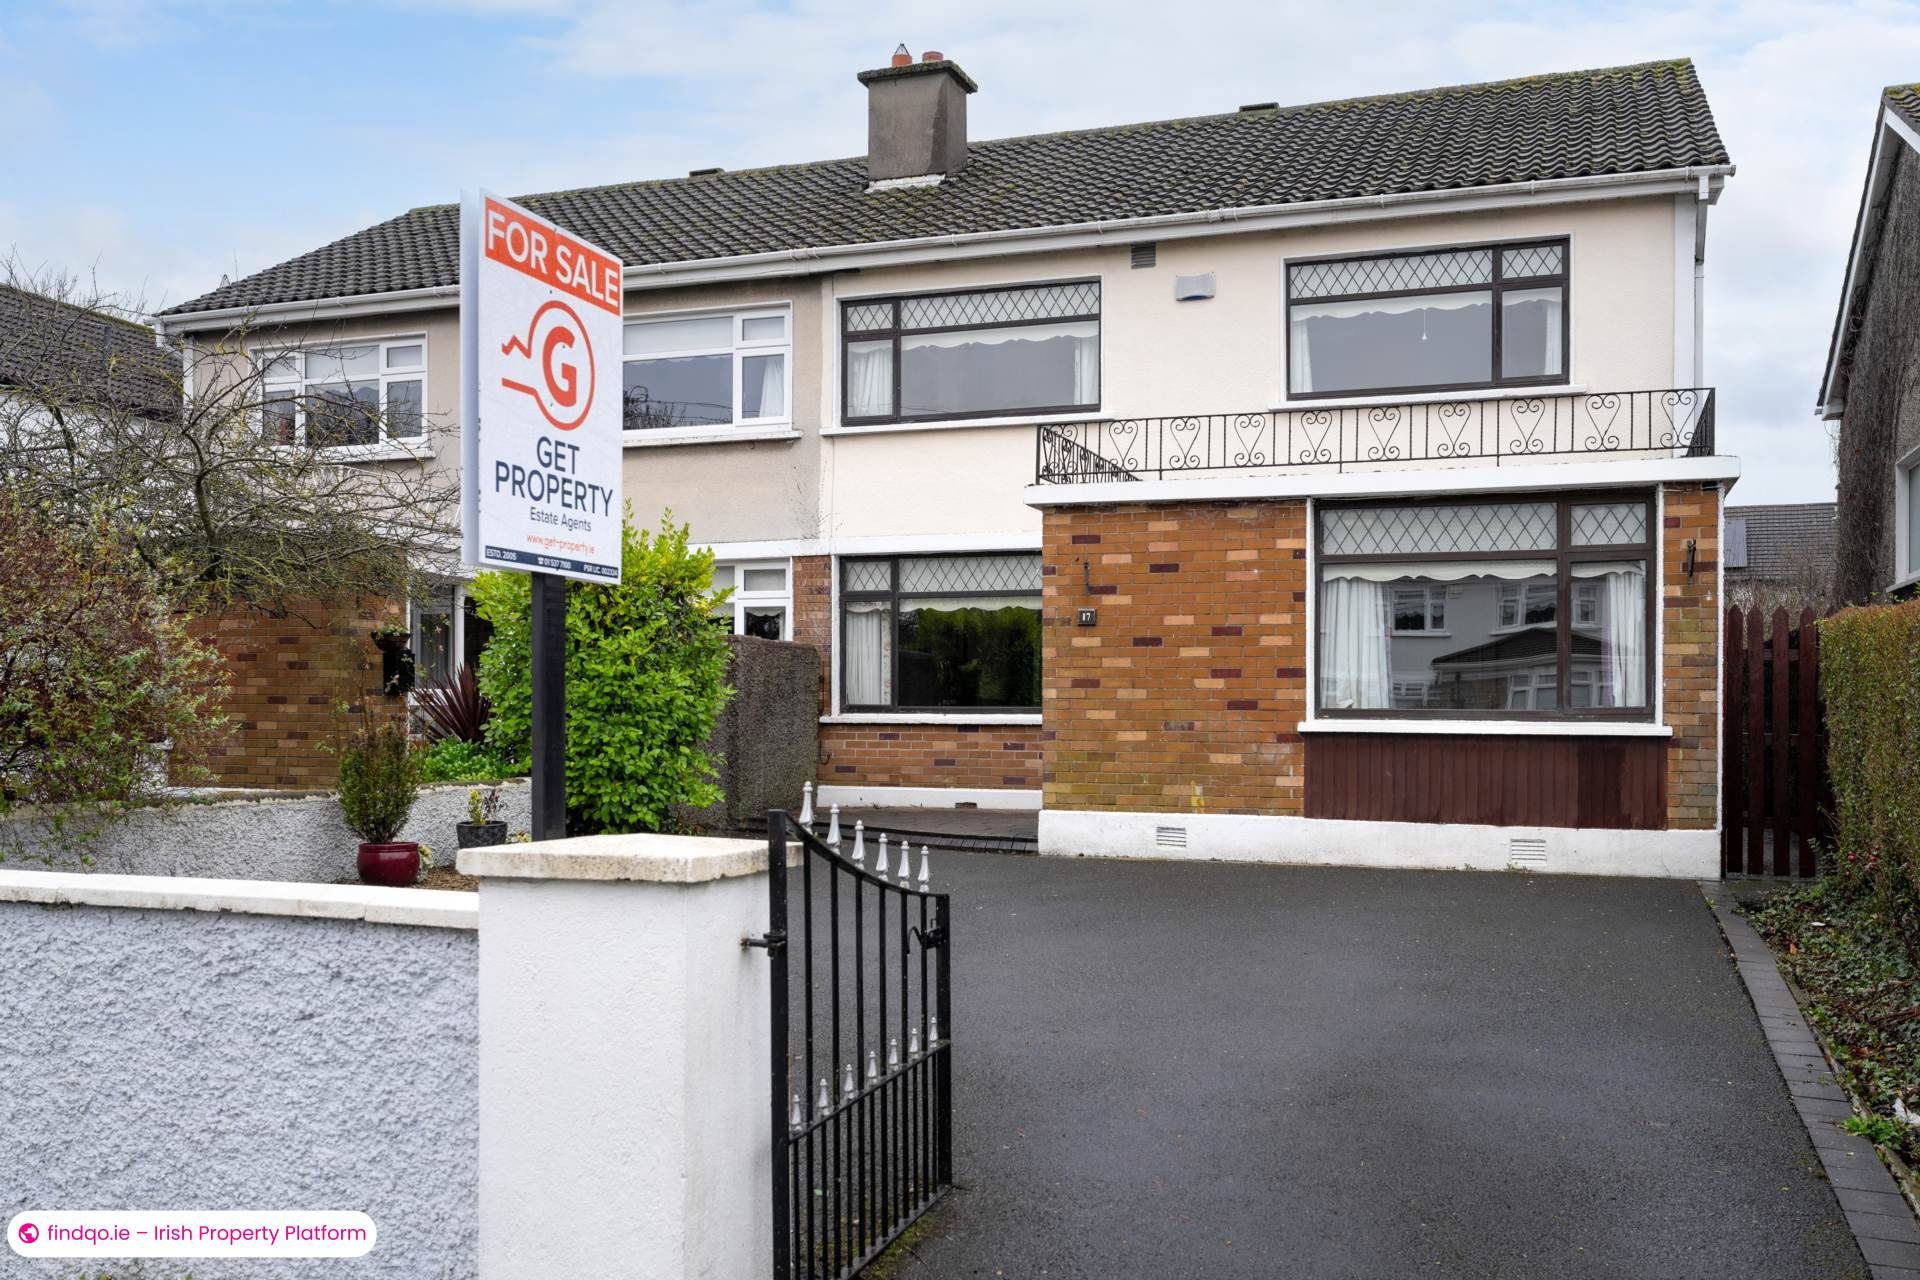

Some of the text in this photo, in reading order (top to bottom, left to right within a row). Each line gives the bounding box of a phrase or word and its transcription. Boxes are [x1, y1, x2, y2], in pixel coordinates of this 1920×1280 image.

[487, 209, 618, 306] FOR SALE
[542, 326, 577, 407] G
[537, 436, 580, 474] GET
[496, 460, 613, 517] PROPERTY
[530, 507, 591, 531] Estate Agents
[1082, 612, 1091, 621] 17
